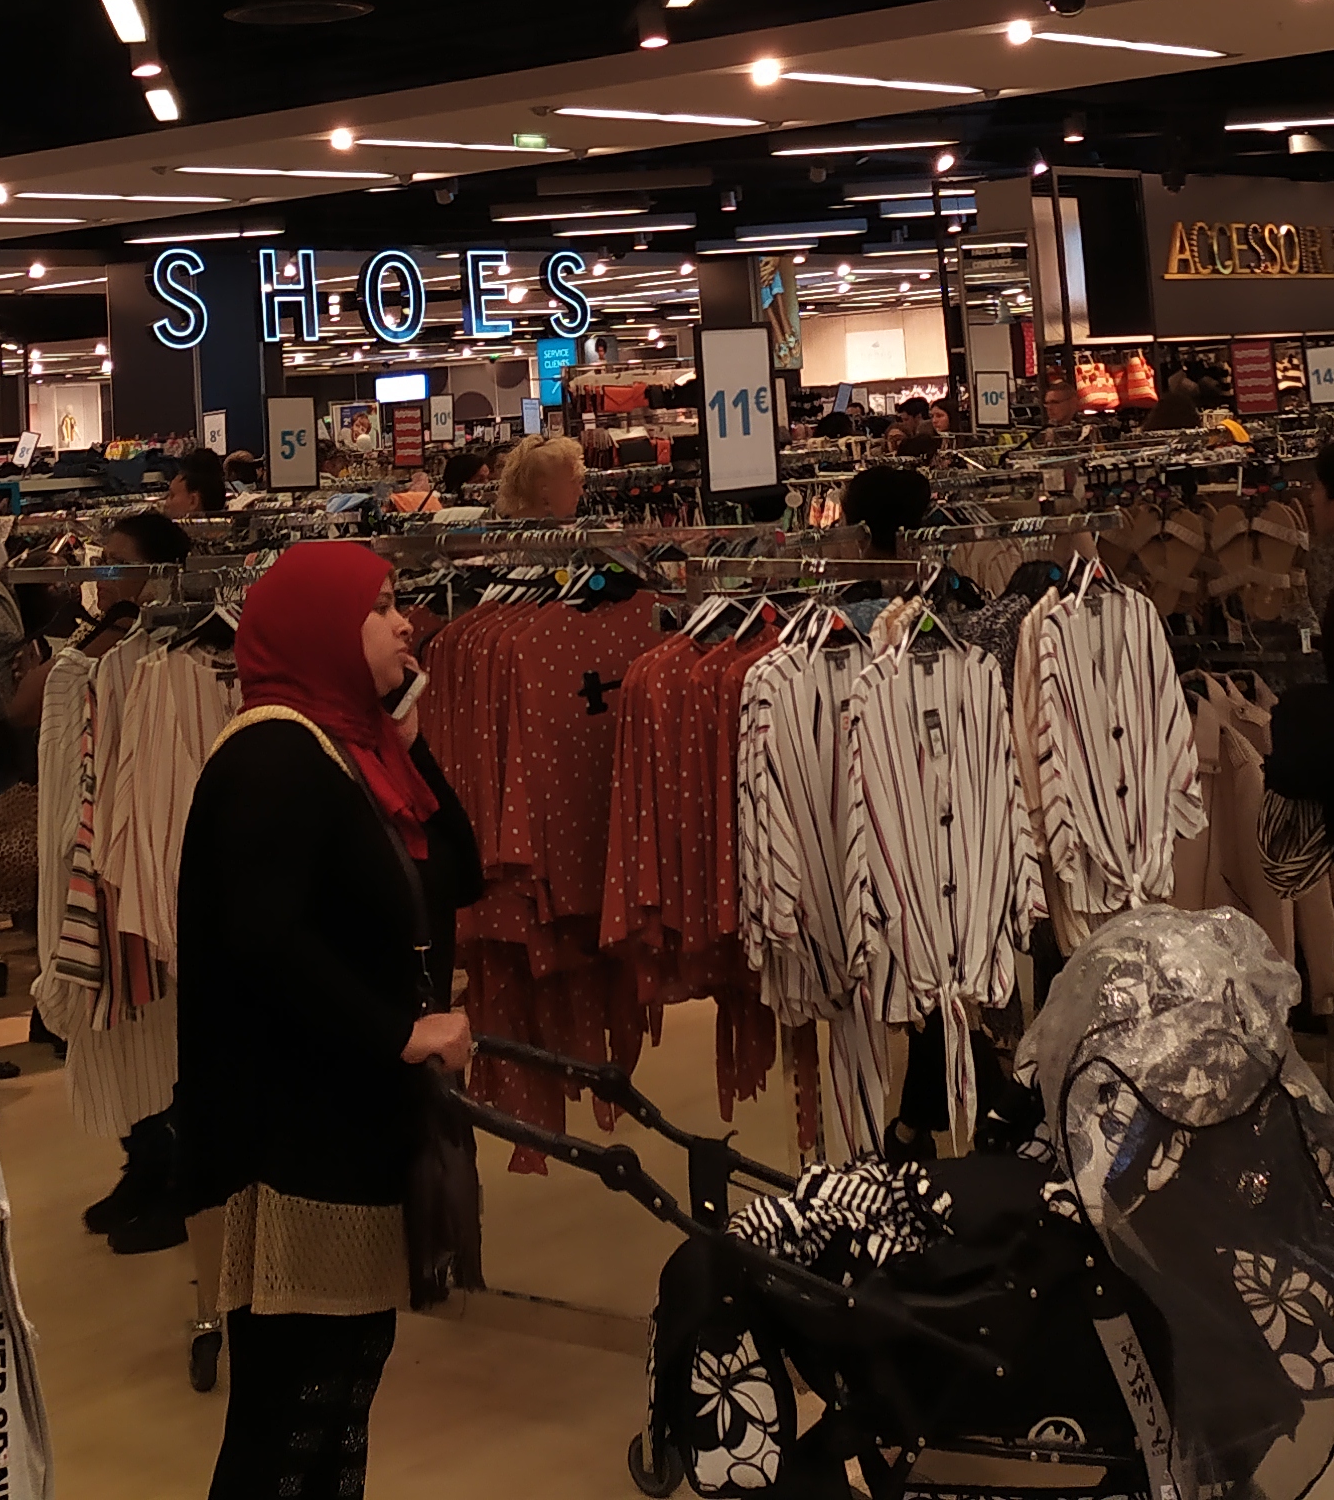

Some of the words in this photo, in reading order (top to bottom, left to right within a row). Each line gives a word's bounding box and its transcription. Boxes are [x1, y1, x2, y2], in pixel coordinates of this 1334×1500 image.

[152, 248, 587, 349] SHOES
[543, 348, 570, 359] SERVICE
[708, 386, 770, 439] 11€
[981, 390, 1006, 406] 10€
[280, 429, 308, 461] 5€
